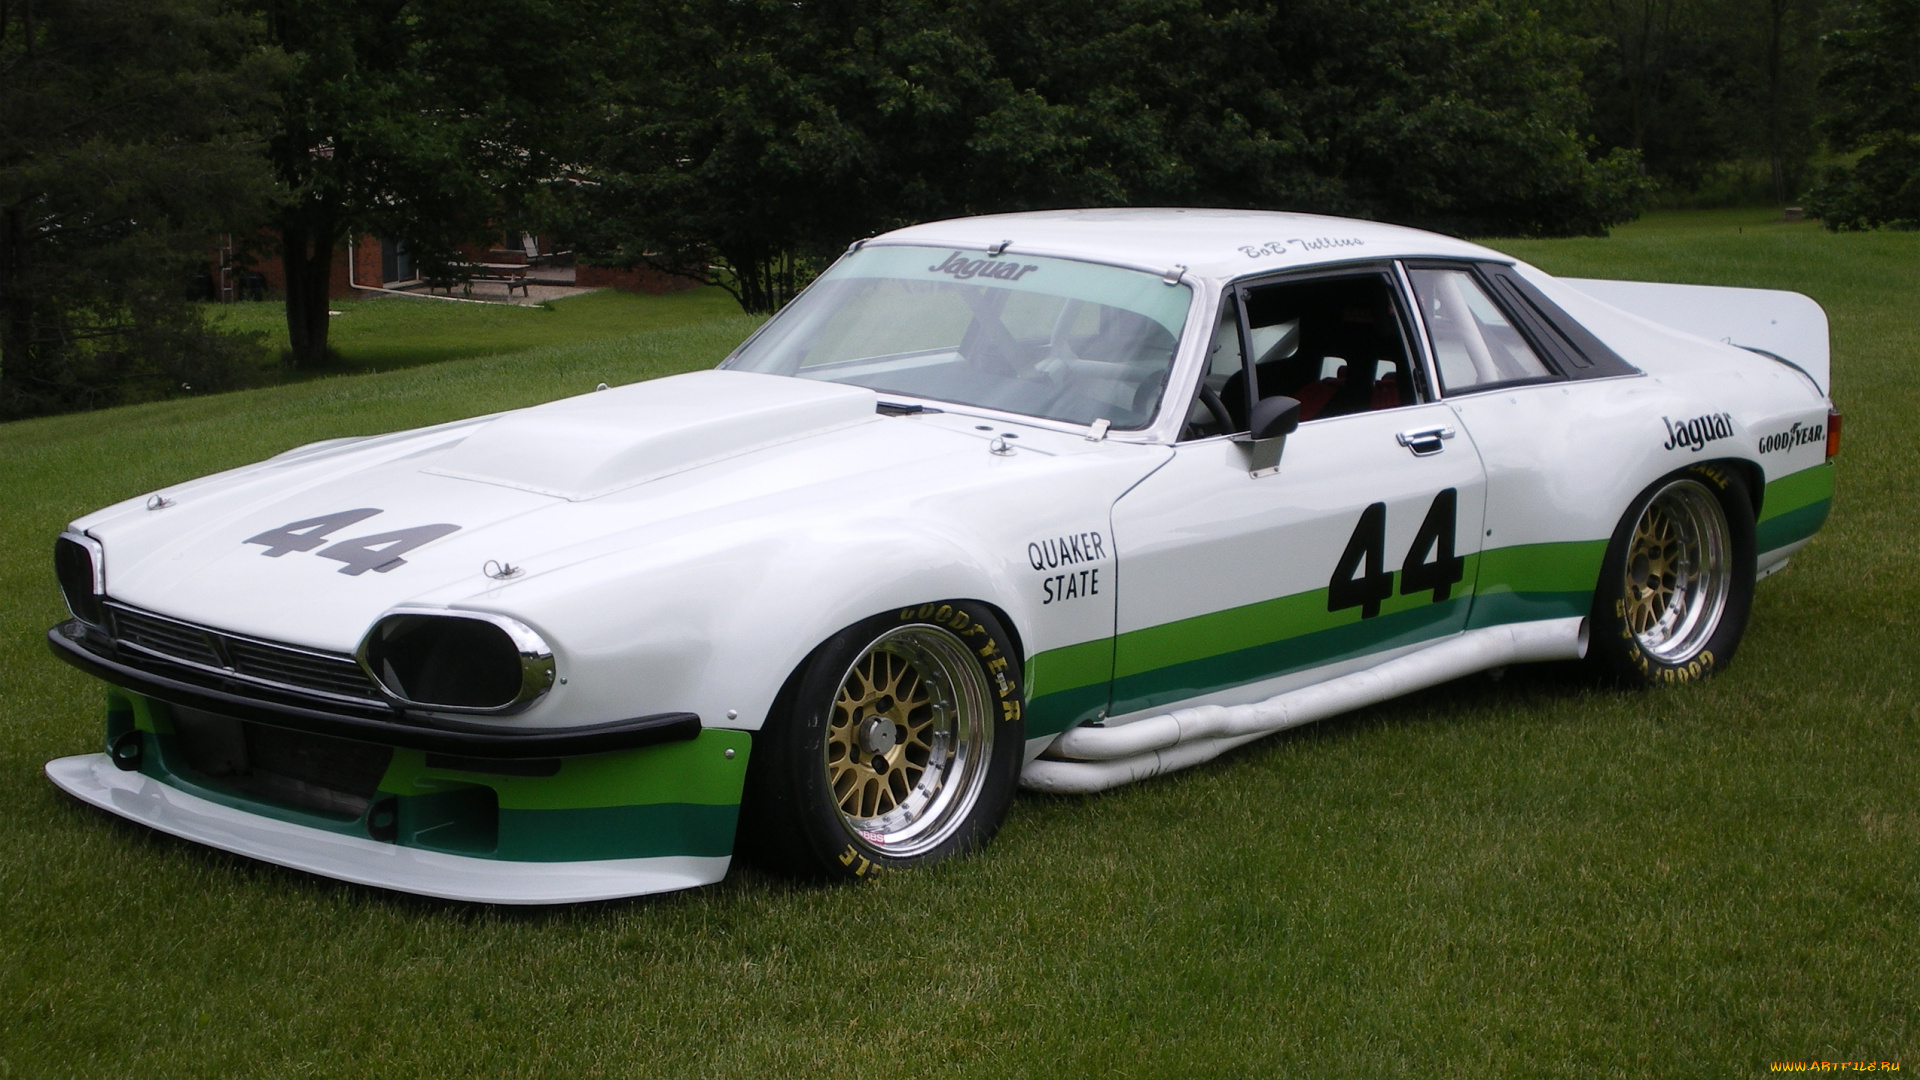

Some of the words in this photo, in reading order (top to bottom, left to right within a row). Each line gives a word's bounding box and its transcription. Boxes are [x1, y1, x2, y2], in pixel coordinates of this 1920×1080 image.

[928, 251, 1039, 281] Jaguar
[1661, 411, 1735, 452] Jaguar
[241, 507, 463, 577] 44
[1028, 531, 1107, 571] QUAKER
[1327, 487, 1465, 620] 44
[1043, 568, 1099, 605] STATE
